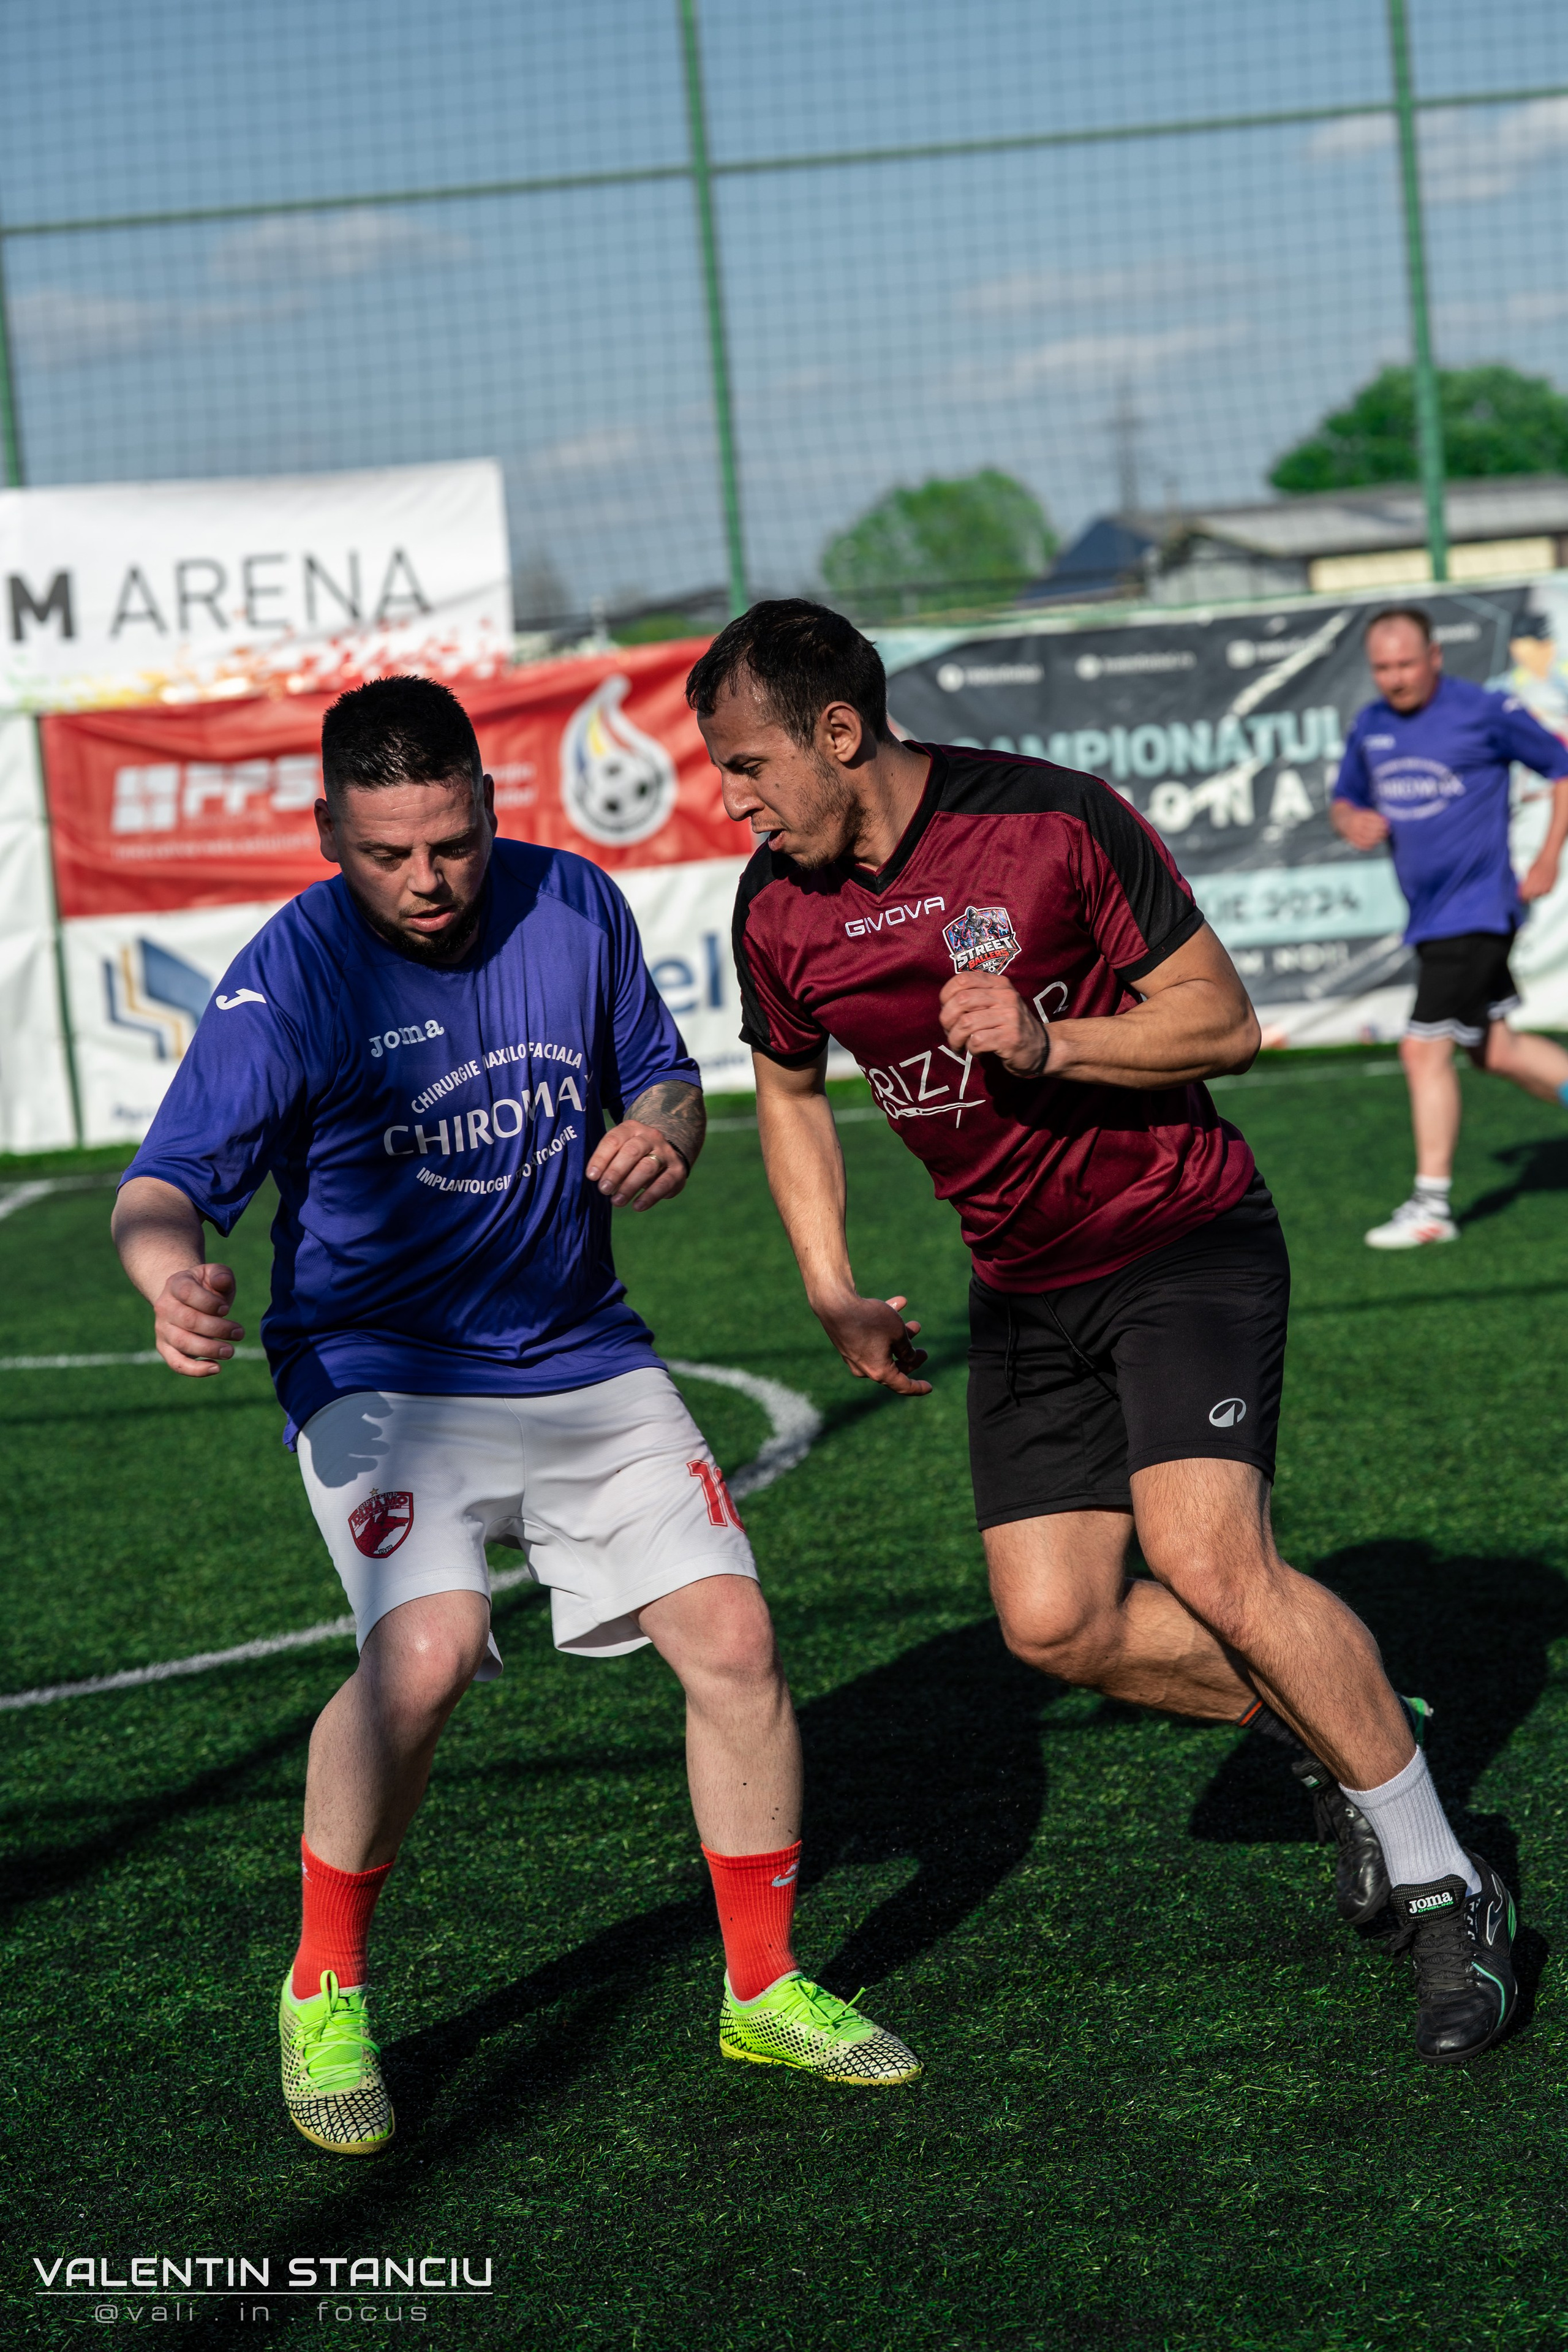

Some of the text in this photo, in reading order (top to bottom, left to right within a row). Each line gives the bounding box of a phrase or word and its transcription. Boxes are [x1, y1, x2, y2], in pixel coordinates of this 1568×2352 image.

[109, 546, 433, 641] ARENA
[949, 704, 1346, 780] MPIONATUL
[845, 896, 946, 937] GIVOVA
[650, 930, 723, 1016] el
[957, 937, 1012, 968] STREET
[968, 949, 1009, 970] BALLERS
[982, 960, 997, 968] MFC
[411, 1060, 480, 1114] CHIRURGIE
[383, 1071, 594, 1156] CHIROMA
[352, 1496, 408, 1525] DINAMO
